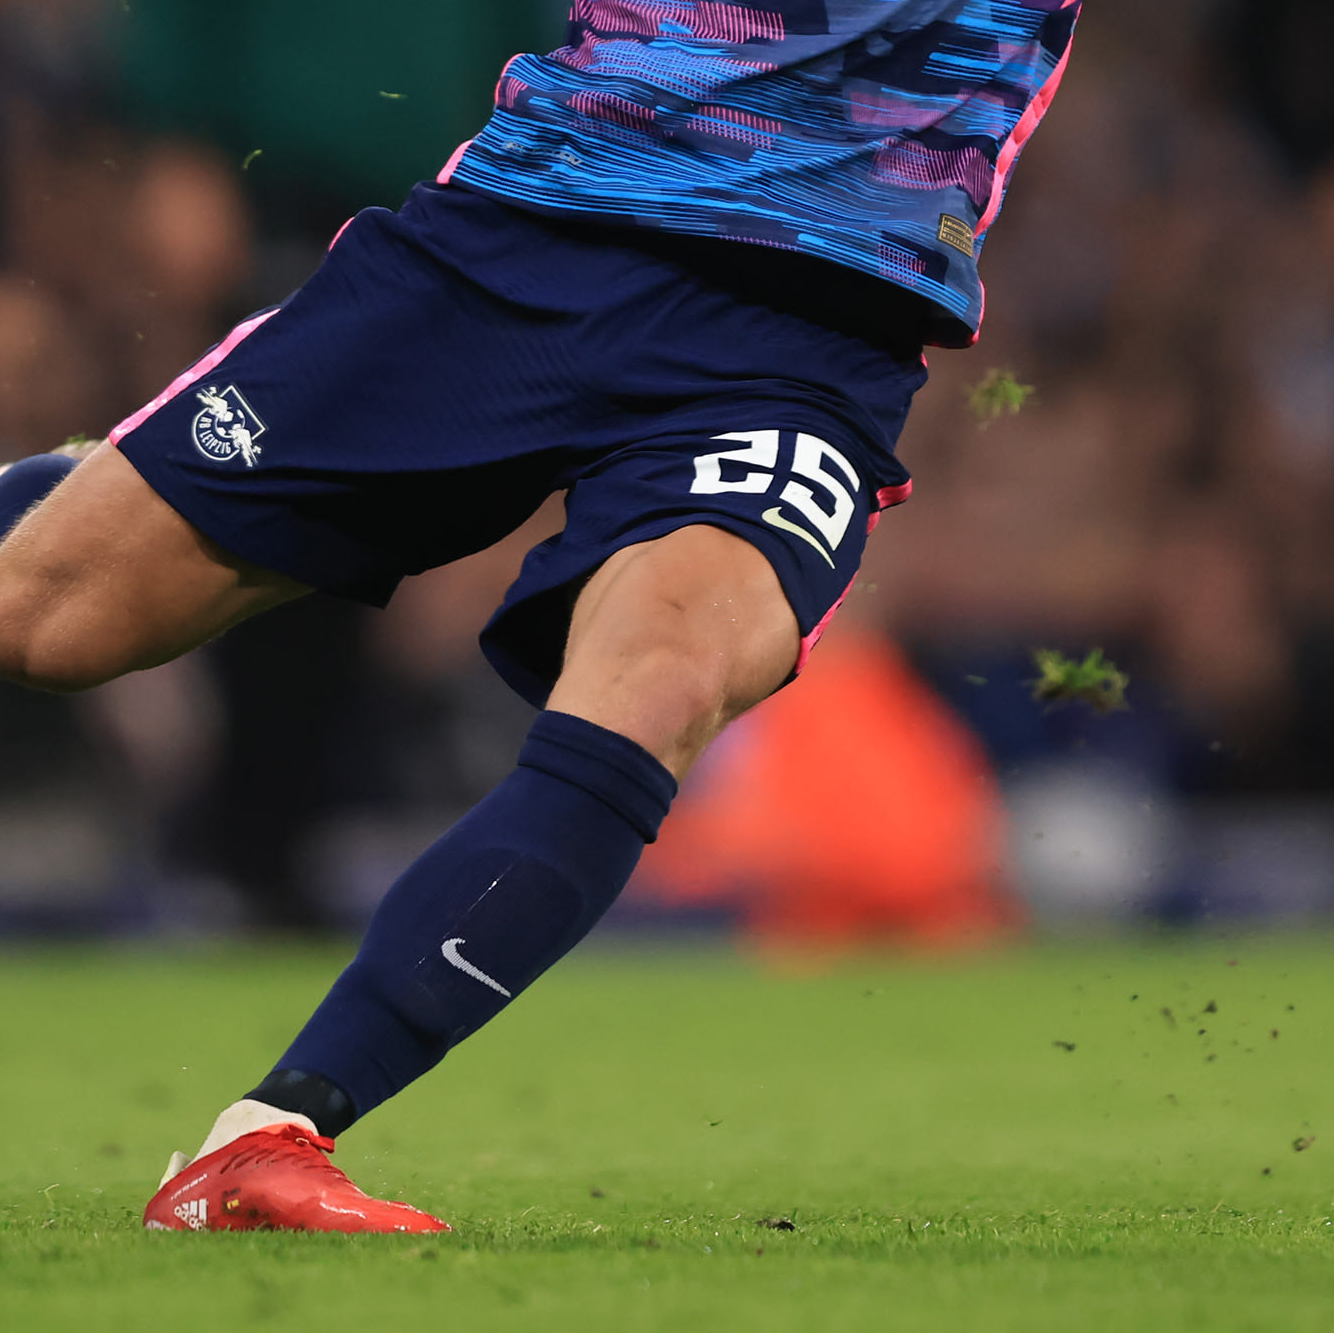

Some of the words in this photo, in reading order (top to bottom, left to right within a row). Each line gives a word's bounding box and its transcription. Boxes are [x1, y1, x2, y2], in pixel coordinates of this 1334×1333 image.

[199, 417, 212, 428] RB
[199, 430, 232, 454] LEIPZIG
[689, 429, 861, 551] 25
